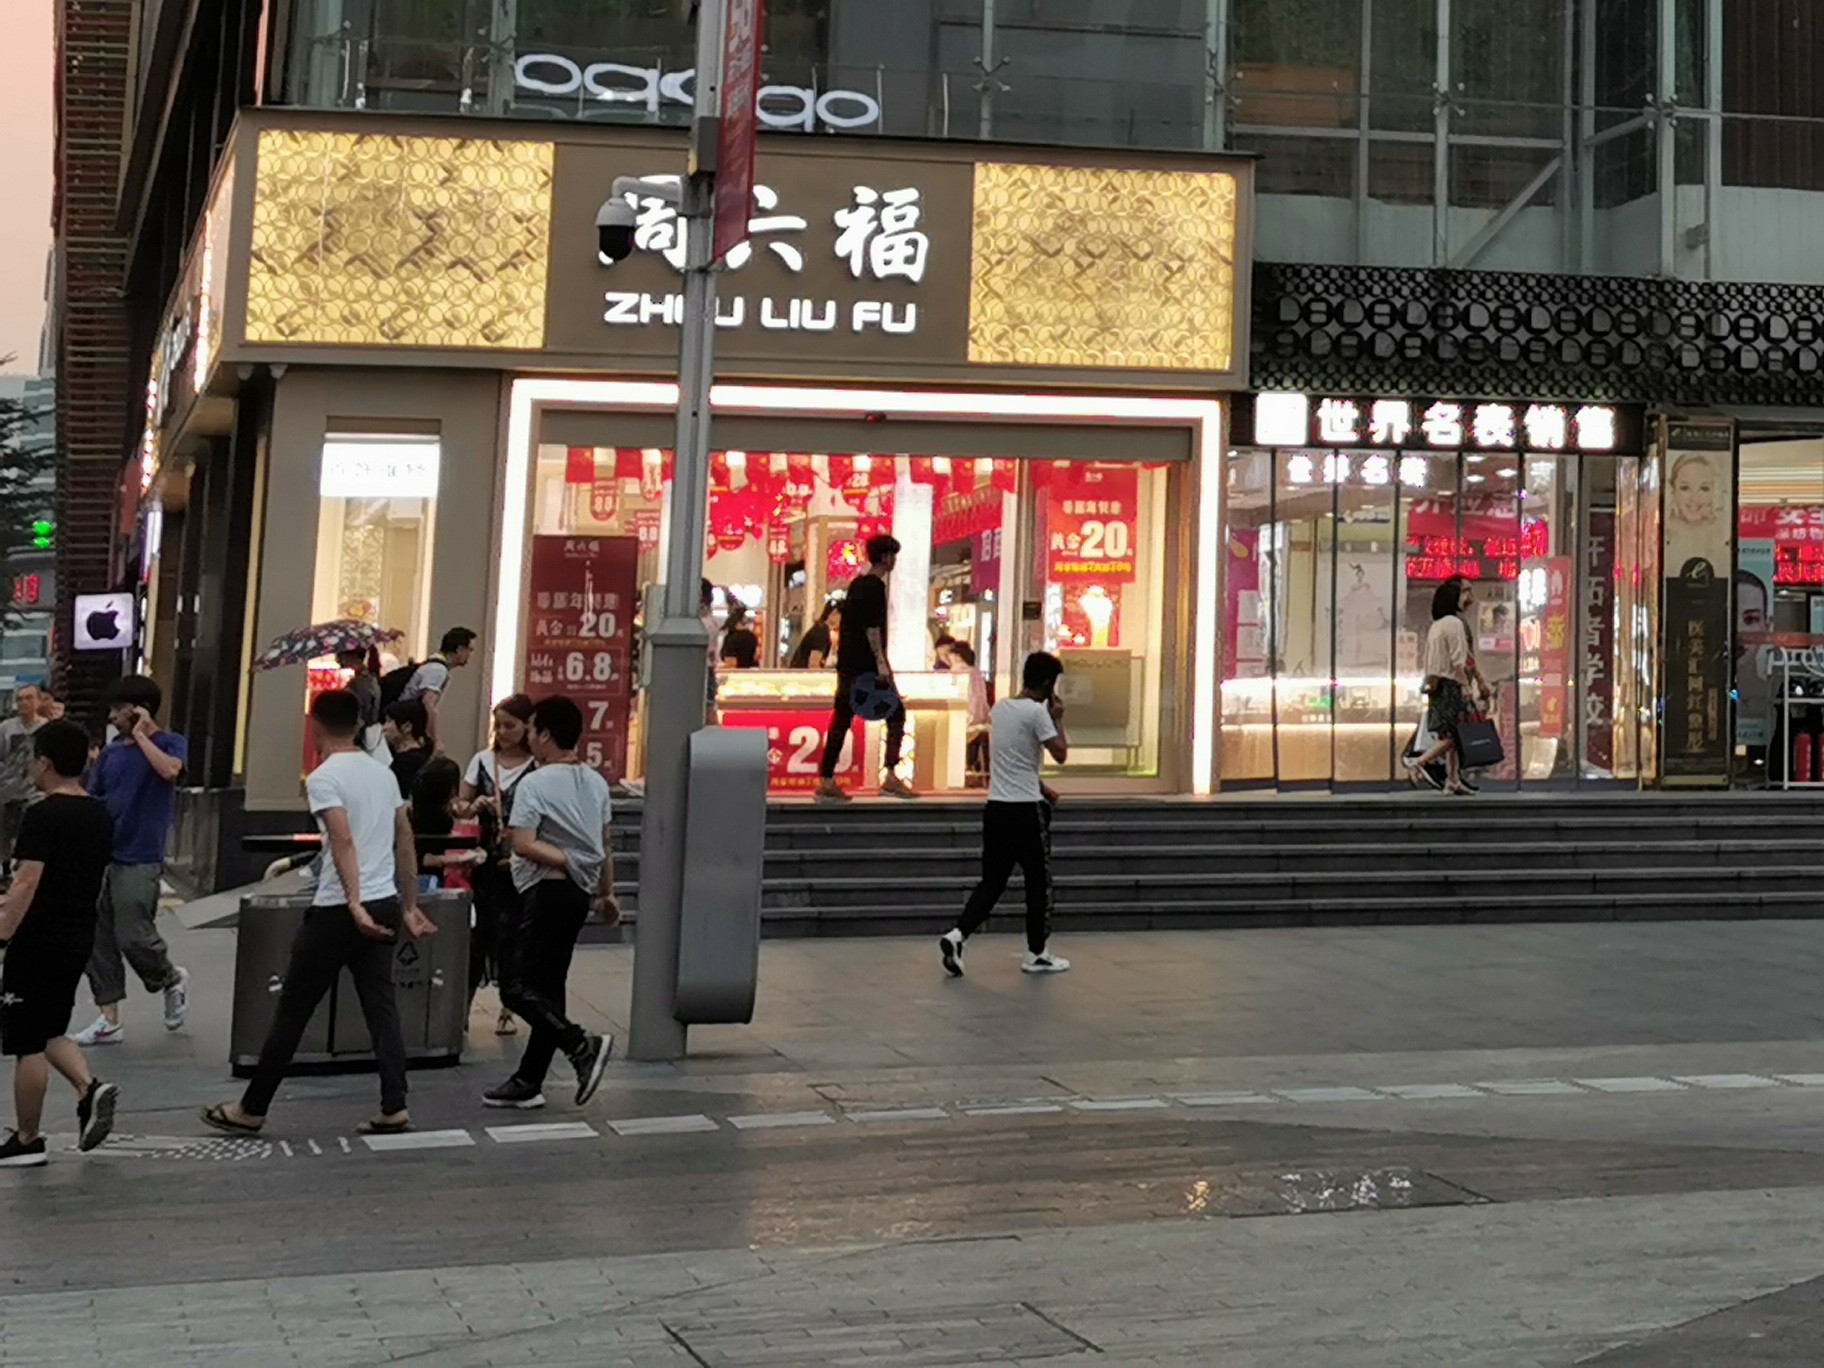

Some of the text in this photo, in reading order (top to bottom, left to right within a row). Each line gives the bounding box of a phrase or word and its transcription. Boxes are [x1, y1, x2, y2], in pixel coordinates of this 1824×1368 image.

[604, 291, 918, 333] ZHU LIU FU
[1080, 519, 1129, 559] 20
[578, 611, 617, 638] 20
[565, 651, 613, 682] 6.8
[587, 700, 610, 731] 7
